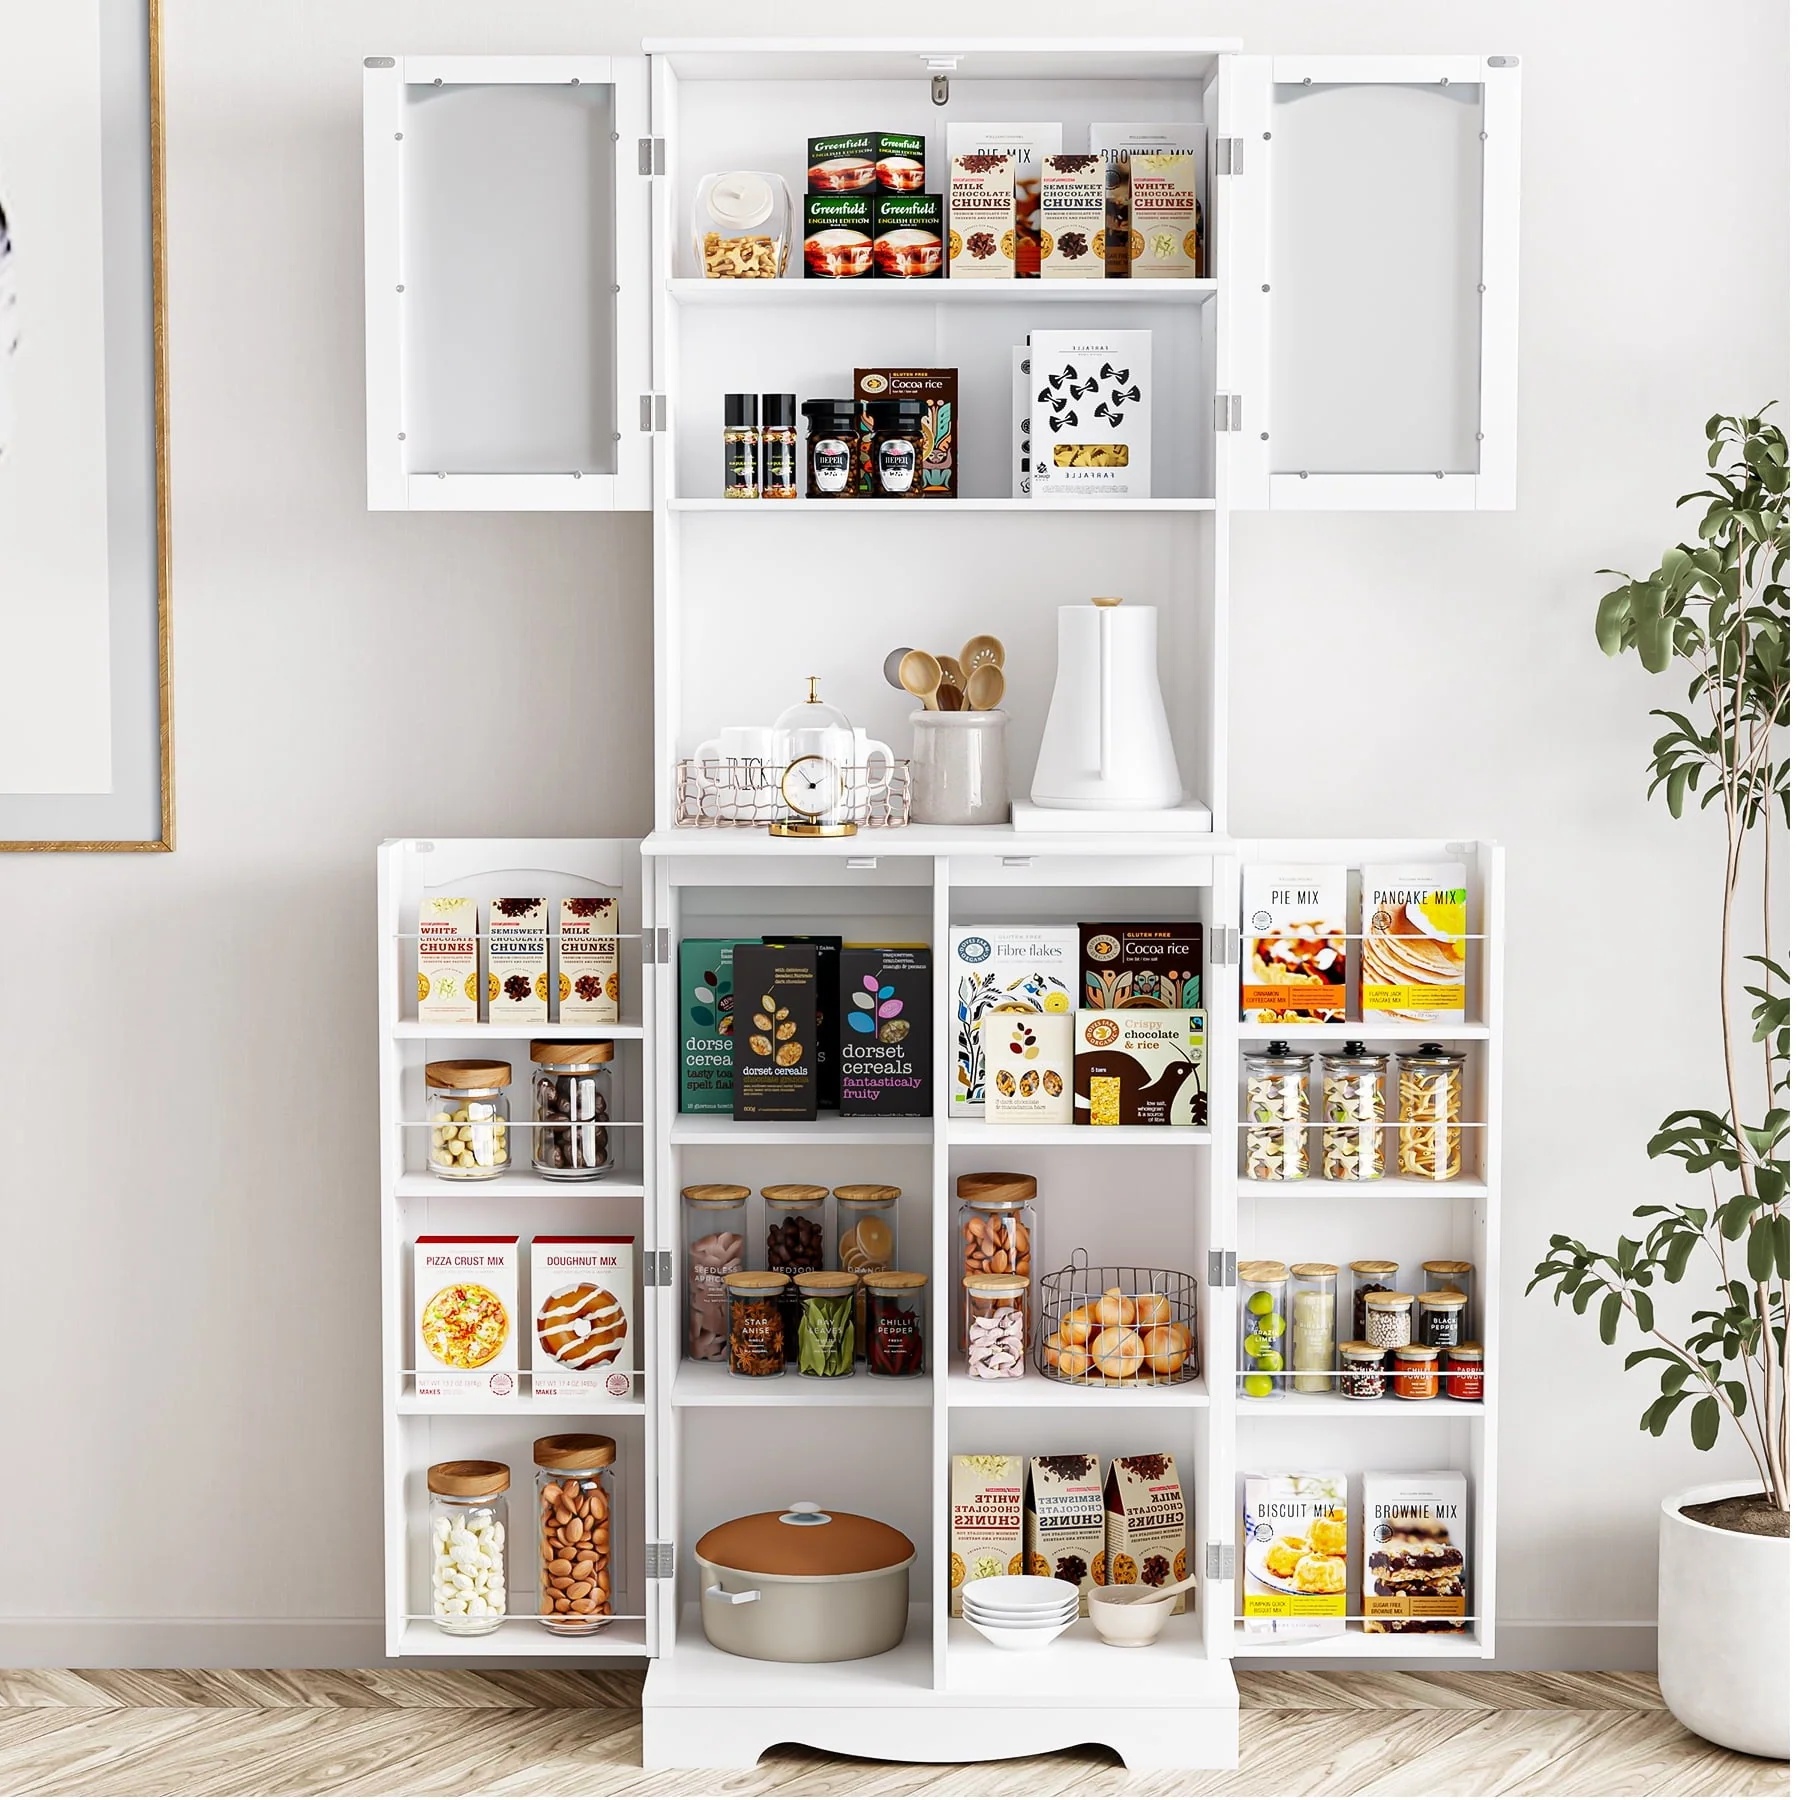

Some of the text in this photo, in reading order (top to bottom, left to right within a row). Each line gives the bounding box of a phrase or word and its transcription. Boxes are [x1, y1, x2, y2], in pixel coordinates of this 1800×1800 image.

[815, 138, 869, 151] Greenfield
[881, 138, 921, 150] Greenfield
[811, 202, 867, 215] Greenfield
[881, 202, 937, 215] Greenfield
[952, 199, 1011, 207] CHUNKS
[1043, 199, 1102, 207] CHUNKS
[1134, 199, 1193, 207] CHUNKS
[892, 380, 943, 389] Cocoa rice
[1272, 891, 1319, 905] PIE MIX
[1374, 891, 1457, 905] PANCAKE MIX
[998, 944, 1062, 956] Fibre flakes
[1126, 942, 1189, 954] Cocoa rice
[1125, 1019, 1163, 1030] Crispy
[1125, 1030, 1179, 1039] chocolate
[686, 1037, 733, 1051] dorse
[1125, 1041, 1159, 1049] & rice
[842, 1044, 905, 1058] dorset
[686, 1055, 733, 1066] cerea
[743, 1066, 773, 1075] dorset
[774, 1066, 808, 1075] cereals
[843, 1060, 912, 1074] cereals
[687, 1069, 714, 1079] tasty
[687, 1081, 713, 1091] spelt
[843, 1077, 922, 1088] fantasticaly
[843, 1089, 880, 1100] fruity
[426, 1257, 504, 1266] PIZZA CRUST MIX
[547, 1257, 617, 1266] DOUGHNUT MIX
[694, 1266, 737, 1274] SEEDLESS
[1259, 1504, 1335, 1518] BISCUIT MIX
[1375, 1504, 1457, 1519] BROWNIE MIX
